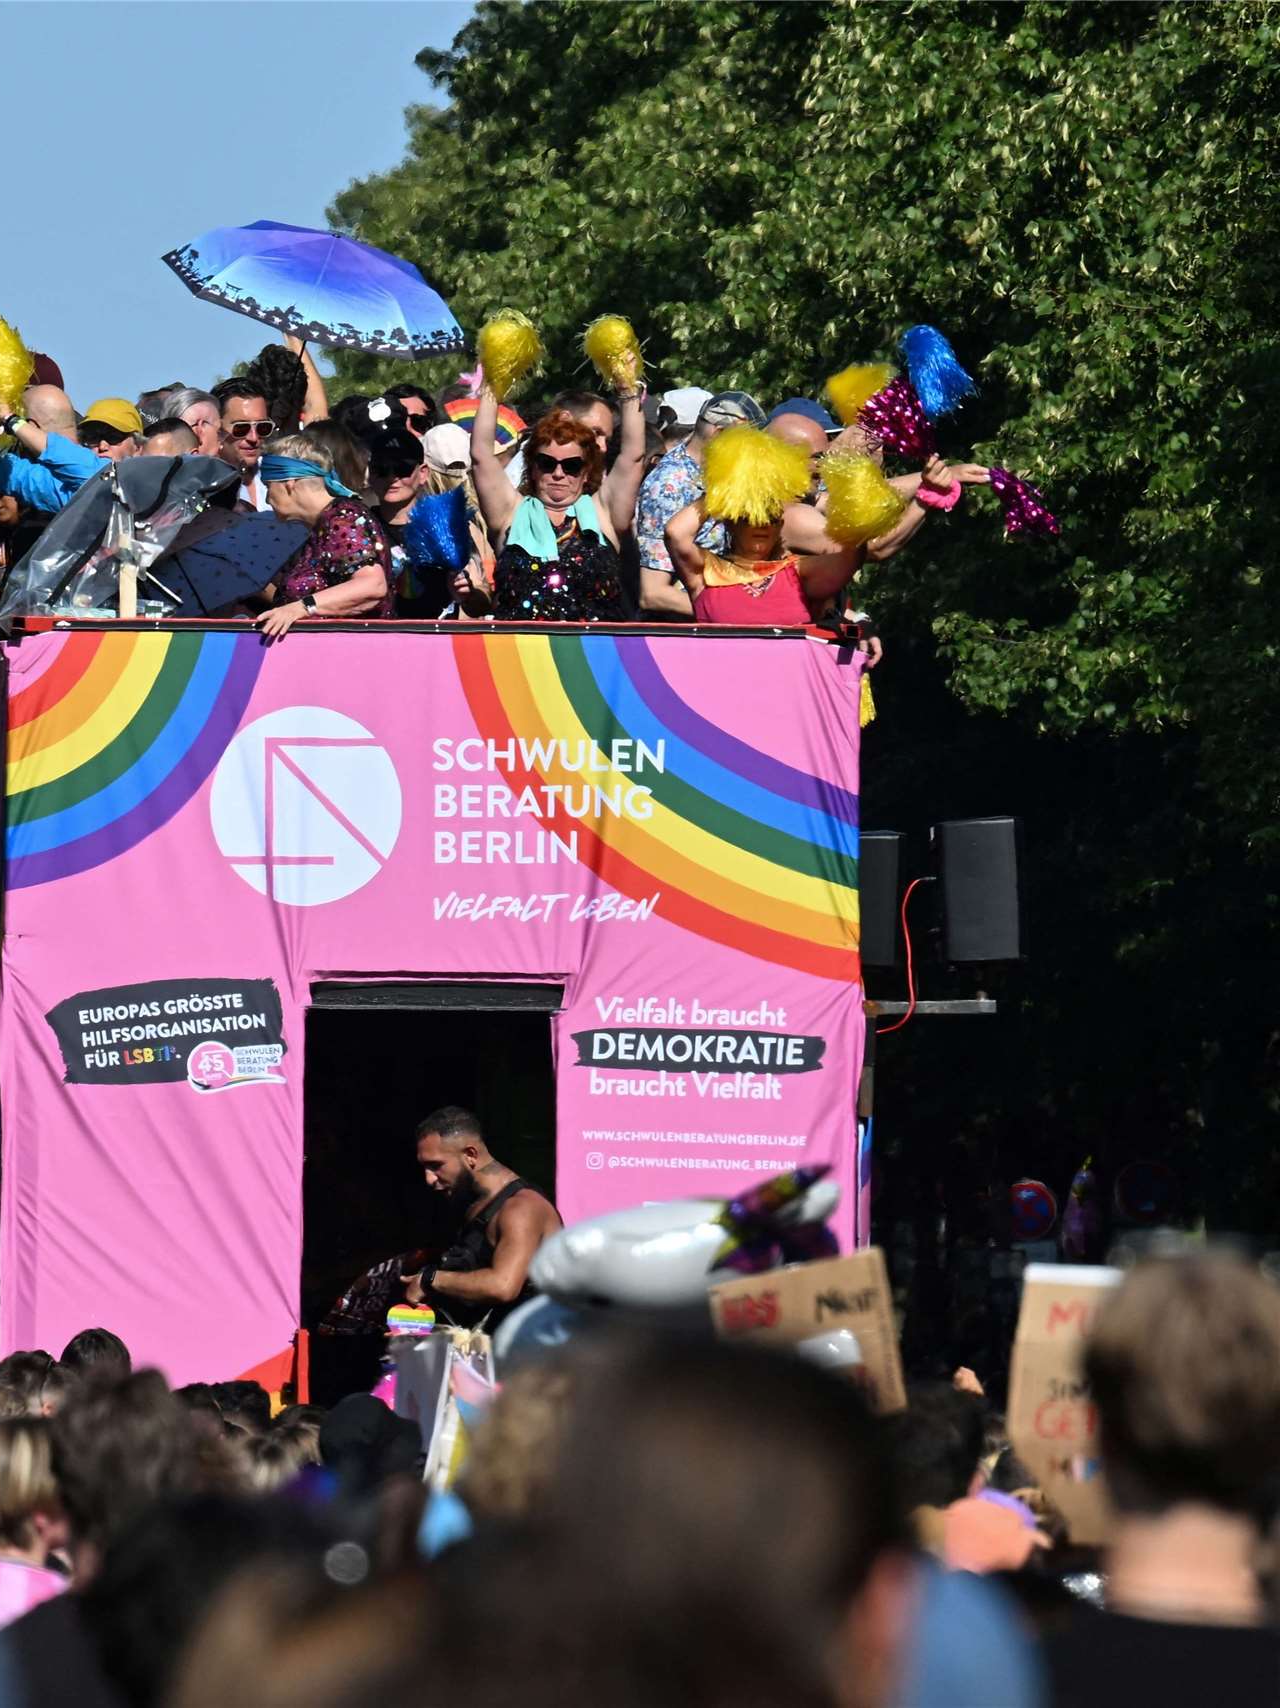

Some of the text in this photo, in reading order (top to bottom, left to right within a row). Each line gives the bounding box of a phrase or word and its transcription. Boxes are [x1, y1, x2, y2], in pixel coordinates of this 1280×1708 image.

[432, 737, 666, 773] SCHWULEN
[433, 784, 654, 819] BERATUNG
[433, 830, 578, 864] BERLIN
[78, 993, 244, 1025] EUROPAS GRÖSSTE
[595, 996, 787, 1027] Vielfalt braucht
[81, 1013, 267, 1048] HILFSORGANISATION
[84, 1051, 120, 1070] FÜR
[198, 1054, 225, 1072] 45
[236, 1056, 279, 1065] BERATUNG
[591, 1032, 805, 1066] DEMOKRATIE
[590, 1069, 783, 1100] braucht Vielfalt
[582, 1130, 807, 1146] WWW.SCHWULENBERATUNGBERLIN.DE
[608, 1157, 797, 1171] @SCHWULENBERATUNG_BERLIN
